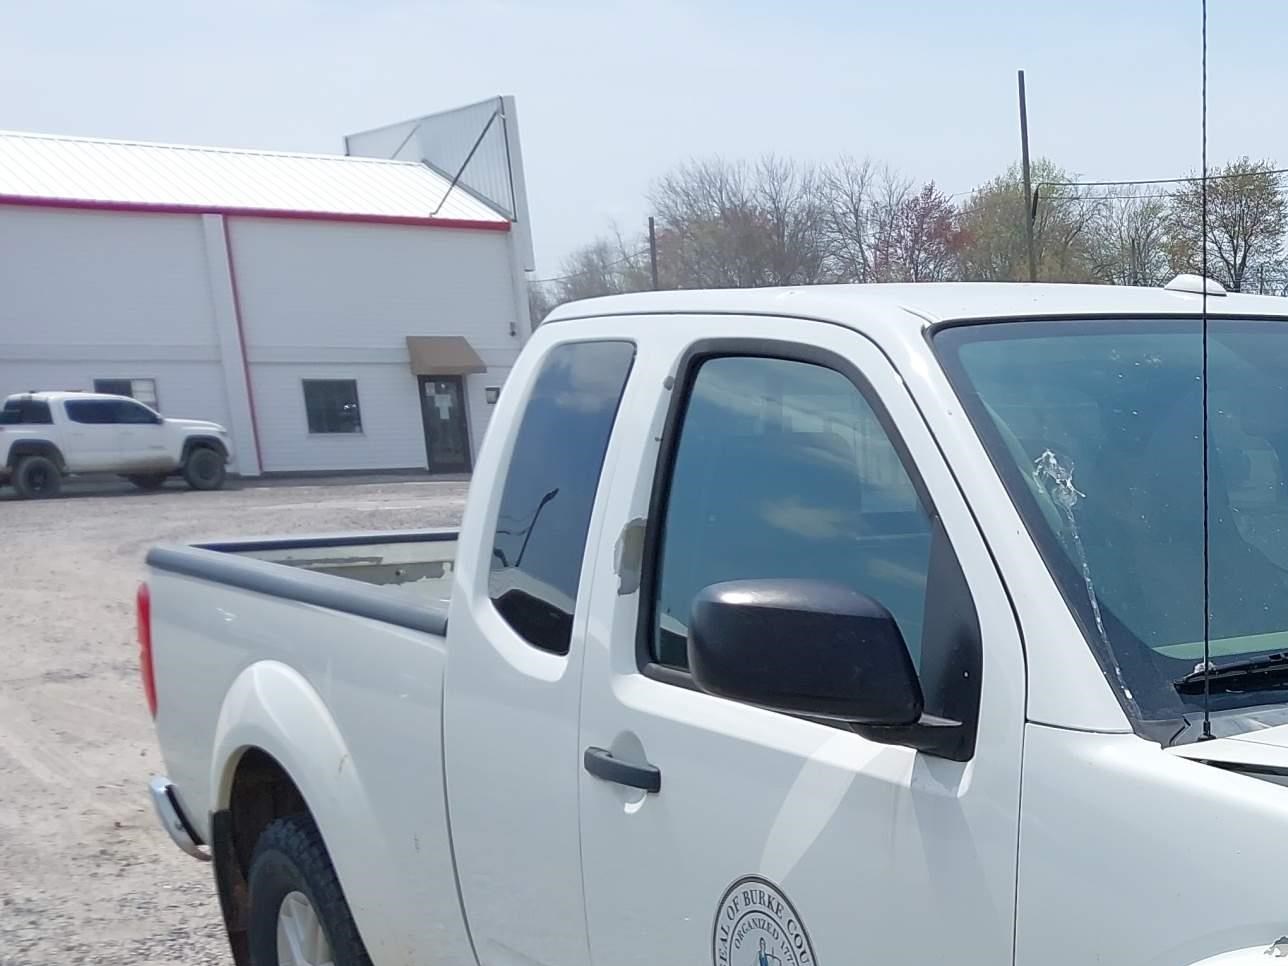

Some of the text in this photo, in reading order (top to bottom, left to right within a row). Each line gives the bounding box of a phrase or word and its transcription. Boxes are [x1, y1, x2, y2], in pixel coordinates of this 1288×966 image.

[727, 898, 739, 921] OF
[743, 889, 783, 918] BURKE
[735, 918, 779, 950] ORGANIZED
